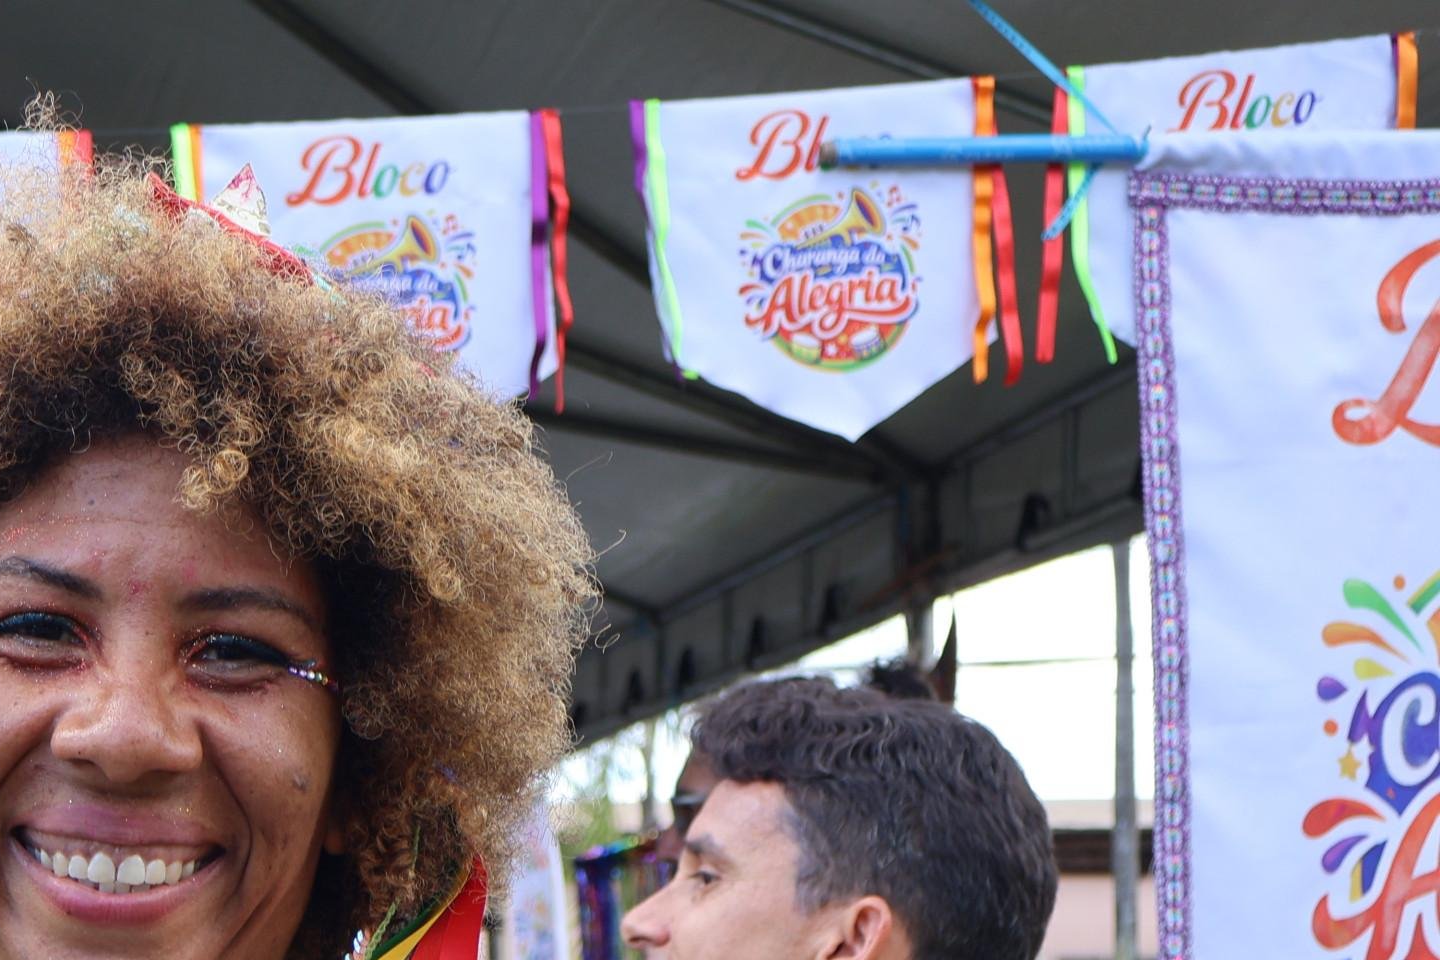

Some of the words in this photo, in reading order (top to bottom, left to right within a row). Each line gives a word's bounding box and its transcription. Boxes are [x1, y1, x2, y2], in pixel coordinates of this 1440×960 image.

[1166, 69, 1320, 132] Bloco
[285, 135, 451, 207] Bloco
[745, 273, 910, 336] Alegria
